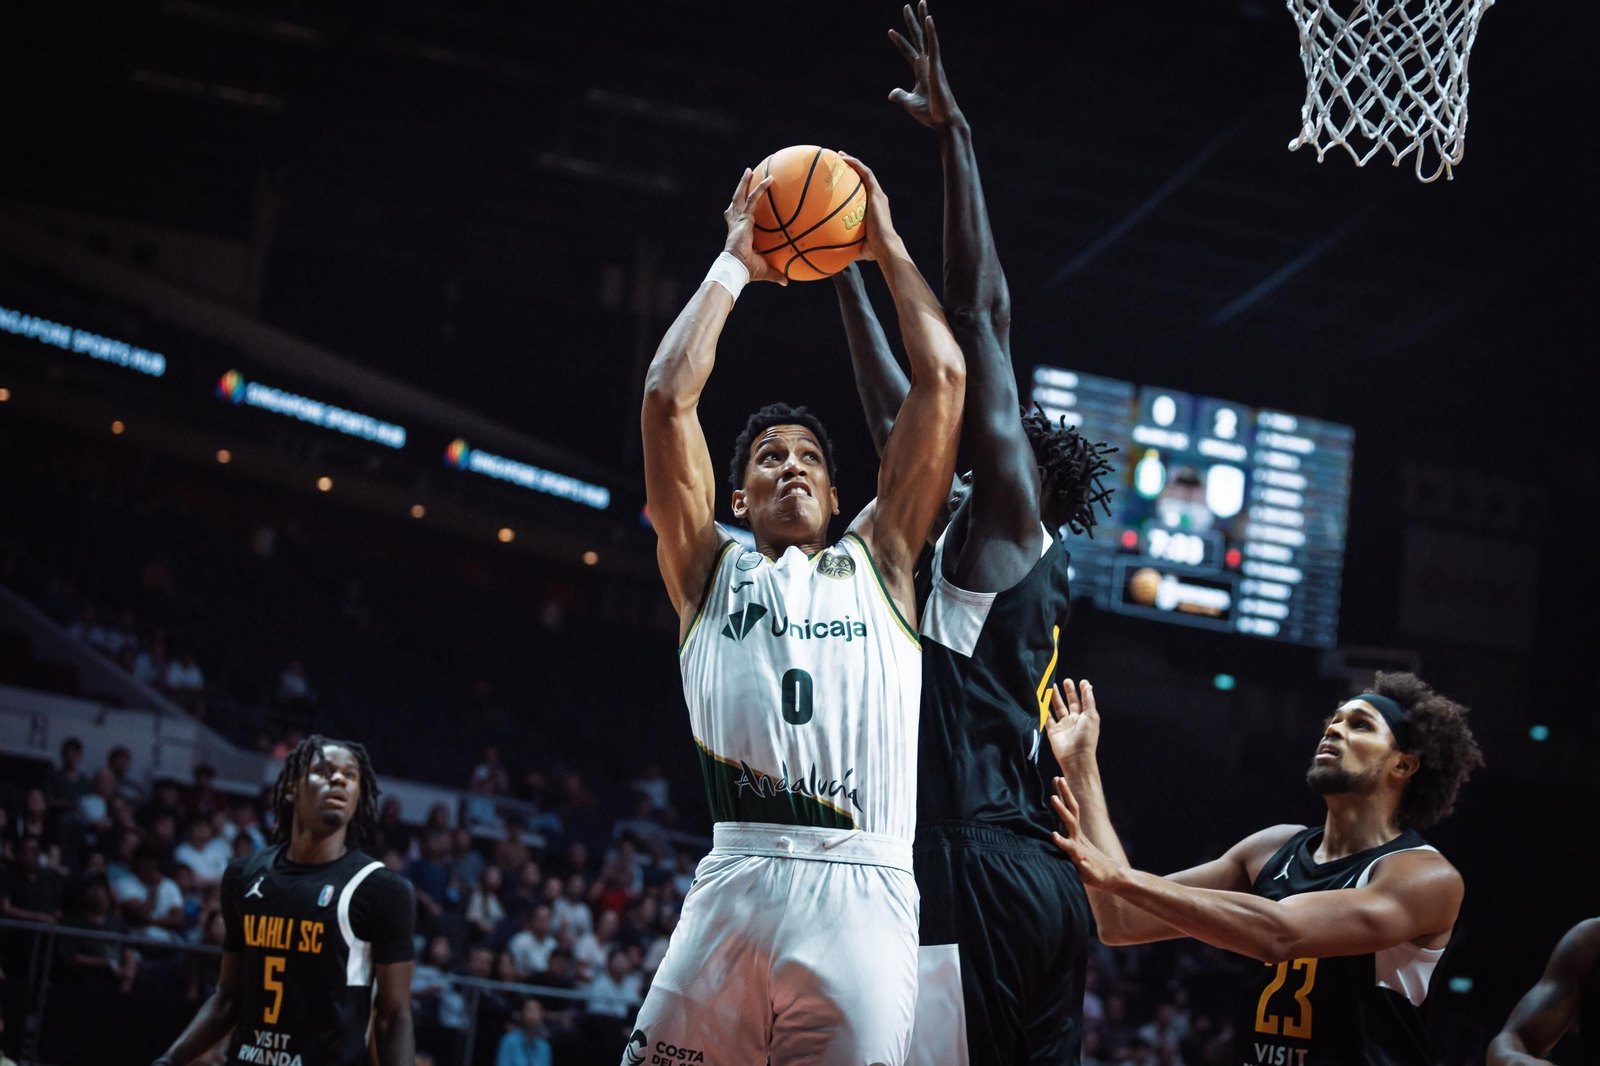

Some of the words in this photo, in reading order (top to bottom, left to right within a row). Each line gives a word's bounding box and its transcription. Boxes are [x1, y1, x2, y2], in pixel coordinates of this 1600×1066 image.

[771, 615, 867, 642] Unicaja
[781, 668, 813, 725] 0
[298, 919, 324, 954] SC
[263, 956, 286, 1024] 5
[1254, 957, 1318, 1039] 23
[254, 1029, 291, 1050] VISIT
[656, 1041, 704, 1063] COSTA
[237, 1043, 303, 1066] RWANDA
[1254, 1042, 1309, 1066] VISIT
